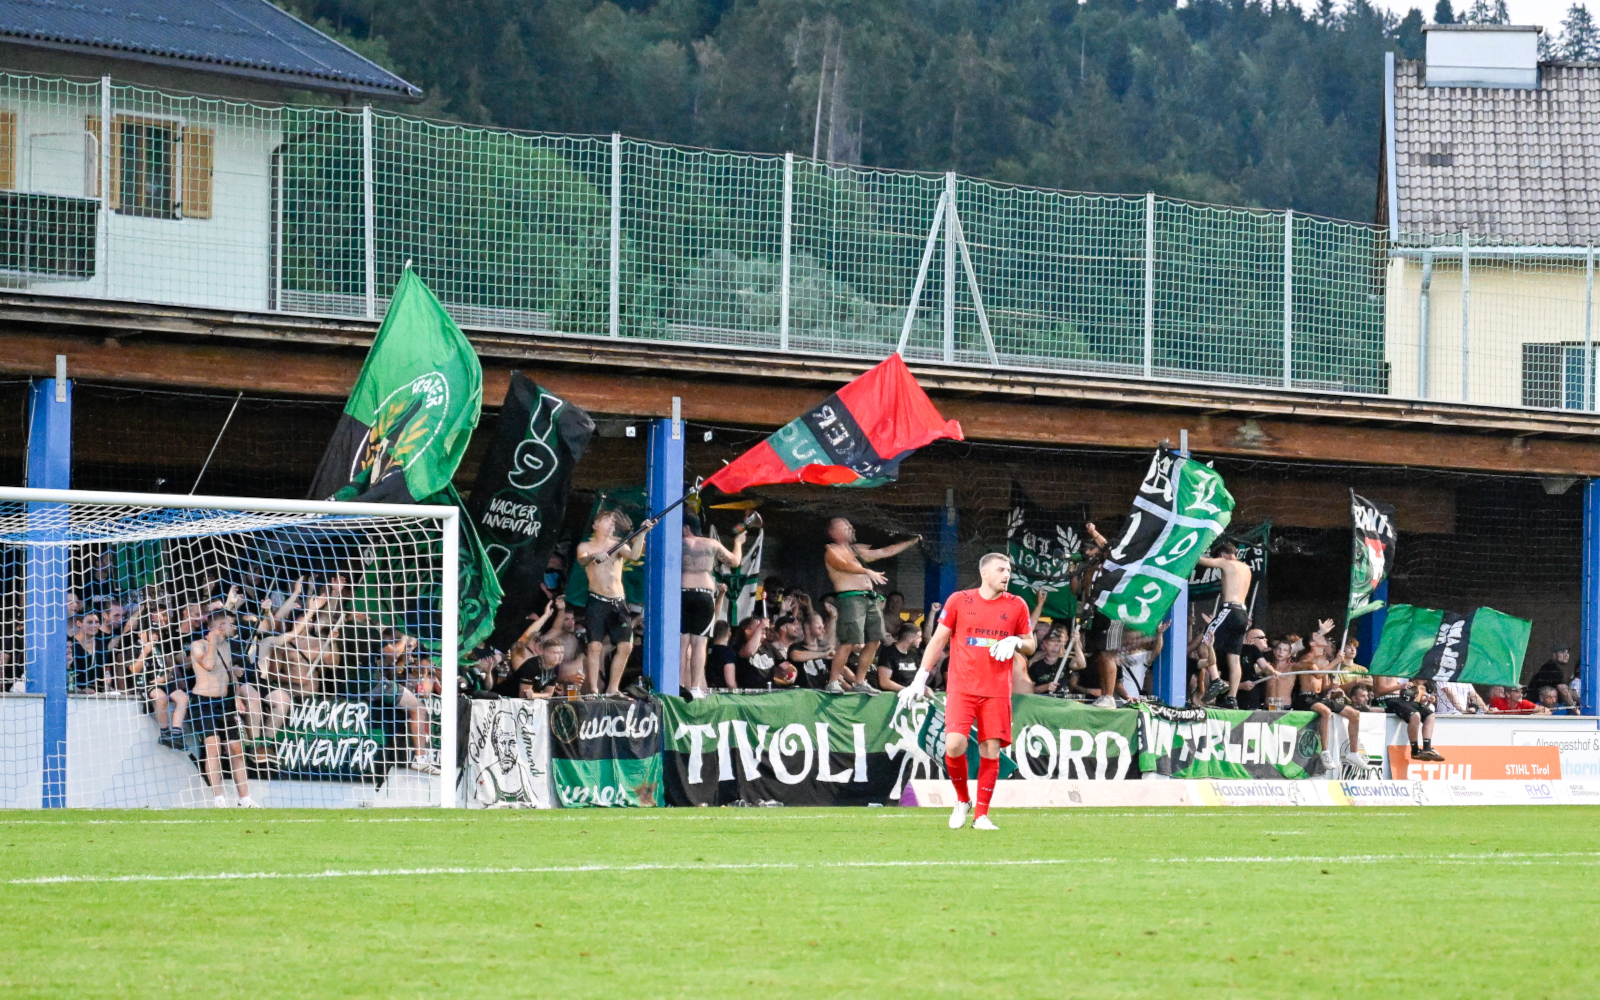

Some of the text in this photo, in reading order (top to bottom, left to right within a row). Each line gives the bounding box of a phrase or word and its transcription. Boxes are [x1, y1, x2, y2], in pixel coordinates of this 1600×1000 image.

[490, 498, 537, 521] WACKER
[482, 512, 541, 537] INVENTAR
[975, 628, 1010, 637] PFEIFER
[290, 698, 369, 735] WACKER
[277, 737, 378, 774] INVENTAR
[674, 720, 868, 785] TIVOLI
[1016, 724, 1132, 780] ORD
[1407, 764, 1472, 780] STIHL
[1505, 764, 1550, 775] STIHL Tirol
[1210, 782, 1285, 796] Hauswitzka
[1340, 782, 1410, 797] Hauswitzka
[1525, 784, 1551, 796] RHO
